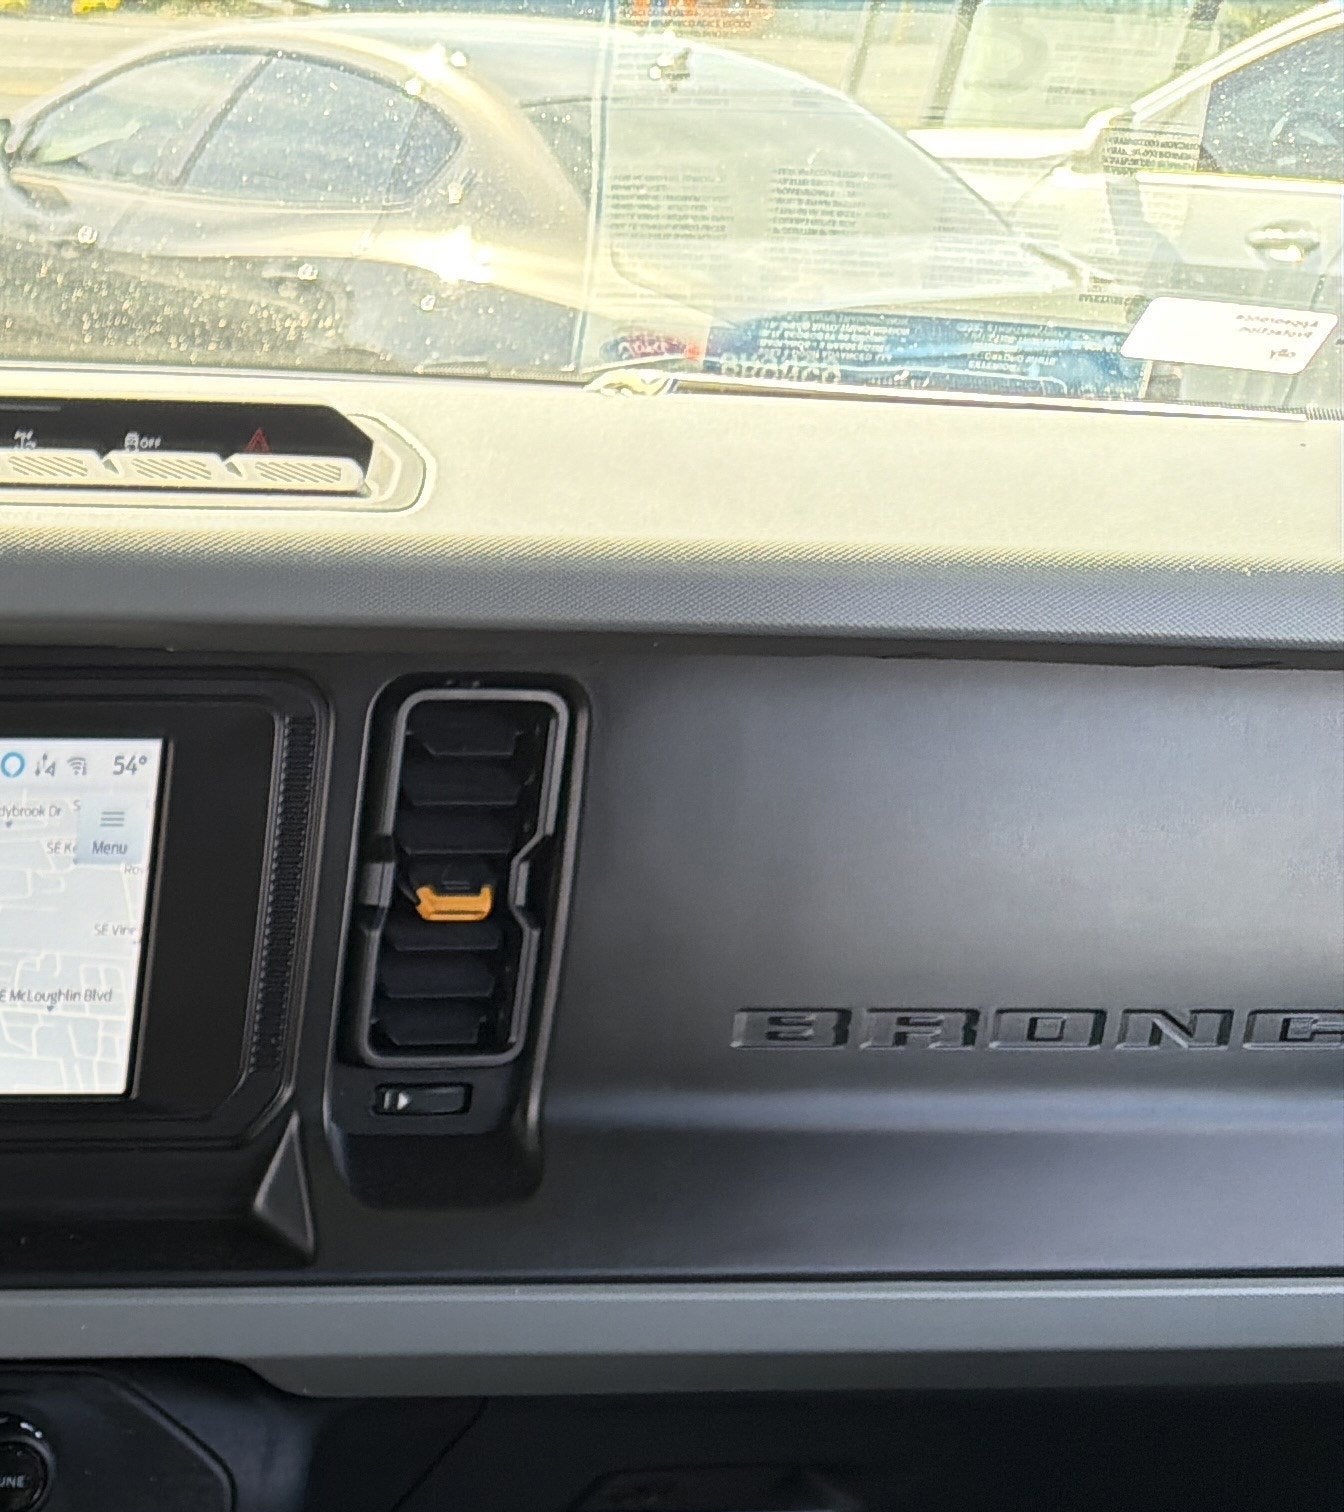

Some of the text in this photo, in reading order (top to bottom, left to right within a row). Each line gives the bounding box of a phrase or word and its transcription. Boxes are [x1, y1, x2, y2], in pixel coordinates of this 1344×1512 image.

[49, 804, 61, 817] Dr
[47, 843, 61, 855] SE
[92, 840, 128, 855] Menu
[94, 924, 108, 937] SE
[9, 989, 81, 1004] McLoughlin
[84, 989, 113, 1002] Blvd
